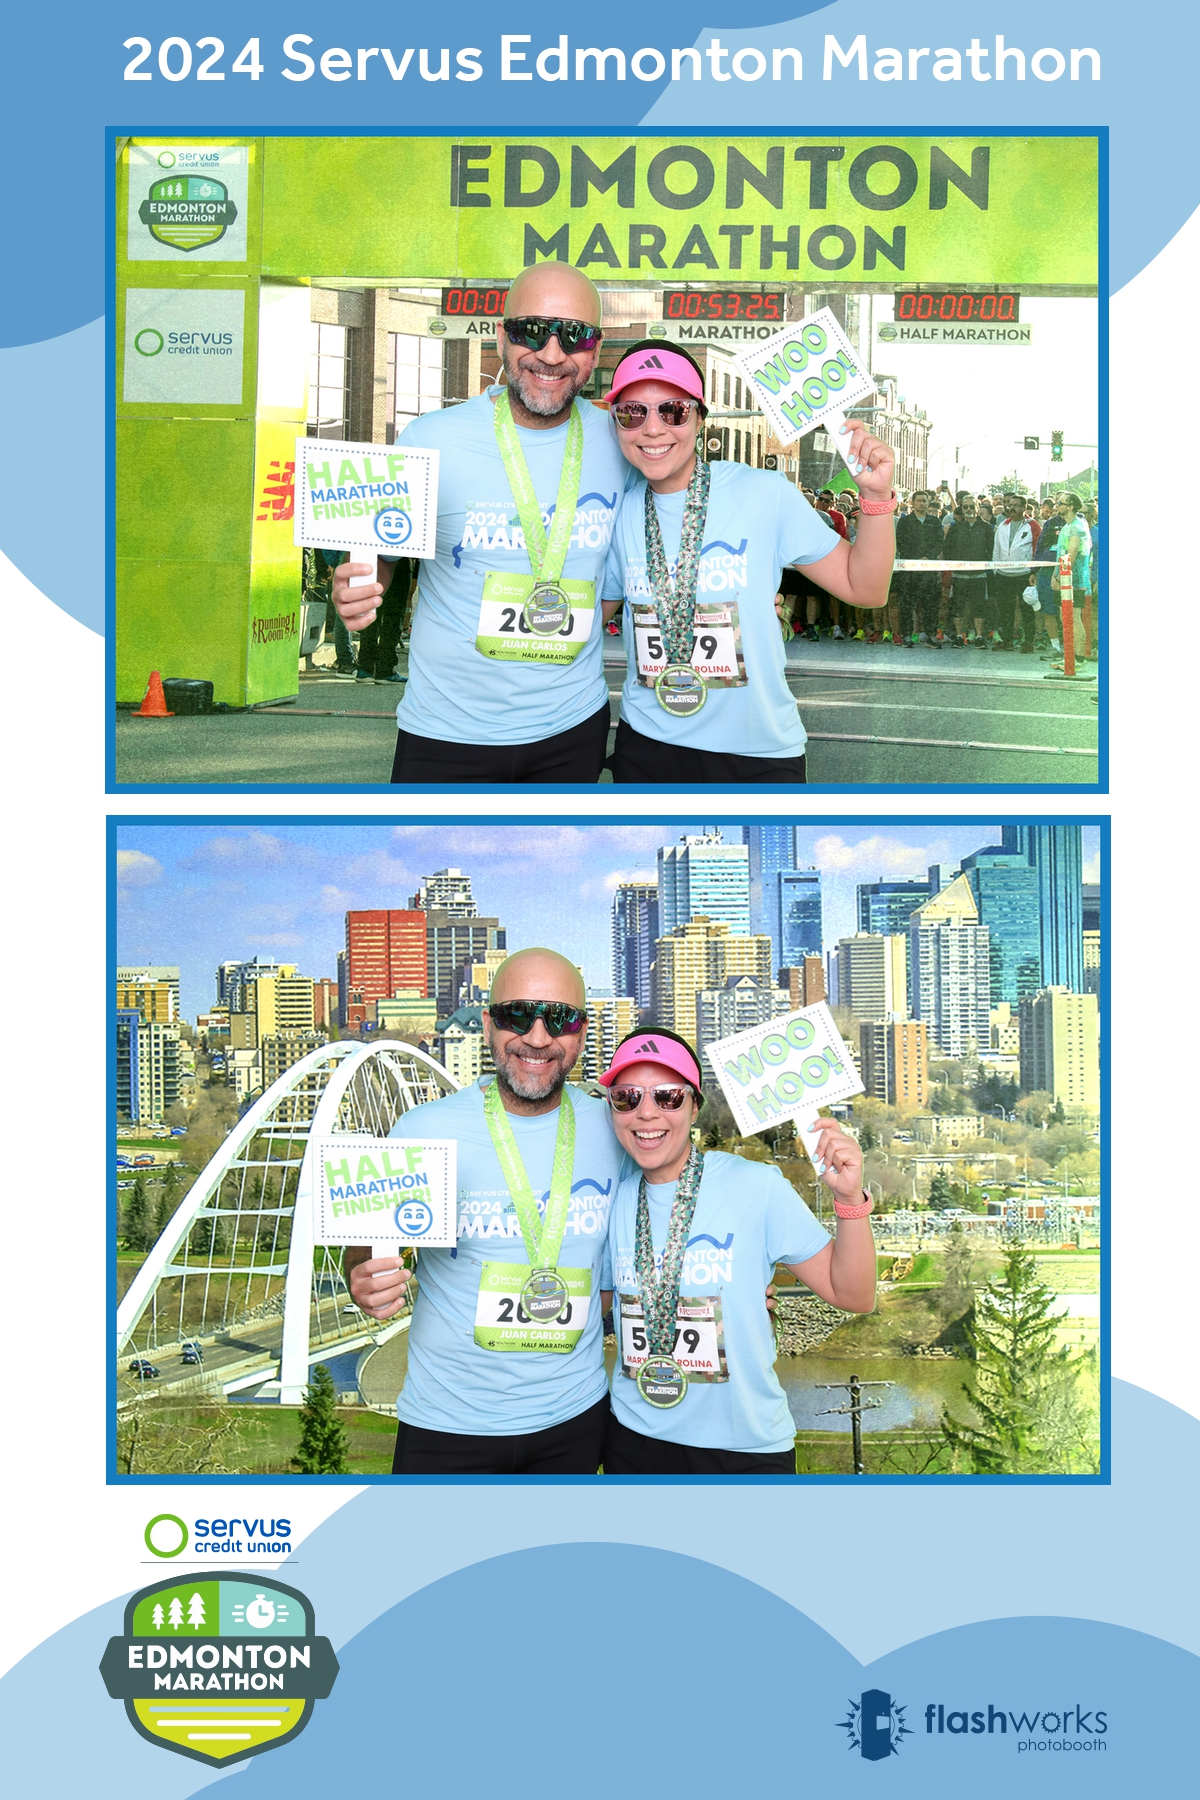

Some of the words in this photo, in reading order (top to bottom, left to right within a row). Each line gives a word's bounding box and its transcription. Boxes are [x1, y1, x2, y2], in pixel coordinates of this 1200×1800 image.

[178, 152, 220, 161] servus
[450, 145, 990, 211] EDMONTON
[149, 203, 227, 214] EDMONTON
[160, 214, 216, 222] MARATHON
[523, 223, 907, 271] MARATHON
[168, 332, 233, 345] servus
[900, 328, 939, 340] HALF
[943, 328, 1031, 341] MARATHON
[168, 345, 200, 354] credit
[203, 347, 233, 355] union
[754, 323, 828, 395] WOO
[780, 349, 858, 431] HOO!
[306, 454, 405, 490] HALF
[511, 453, 524, 488] MARATHON
[310, 481, 409, 503] MARATHON
[465, 512, 508, 527] 2024
[460, 525, 614, 550] MARHON
[501, 639, 529, 649] JUAN
[531, 641, 568, 652] CARLOS
[724, 1017, 816, 1087] WOO
[746, 1045, 845, 1124] HOO!
[324, 1146, 423, 1187] HALF
[501, 1140, 517, 1175] MARATHON
[329, 1172, 429, 1201] MARATHON
[459, 1200, 503, 1215] 2024
[456, 1209, 609, 1239] MARHON
[500, 1329, 527, 1339] JUAN
[530, 1331, 566, 1340] CARLOS
